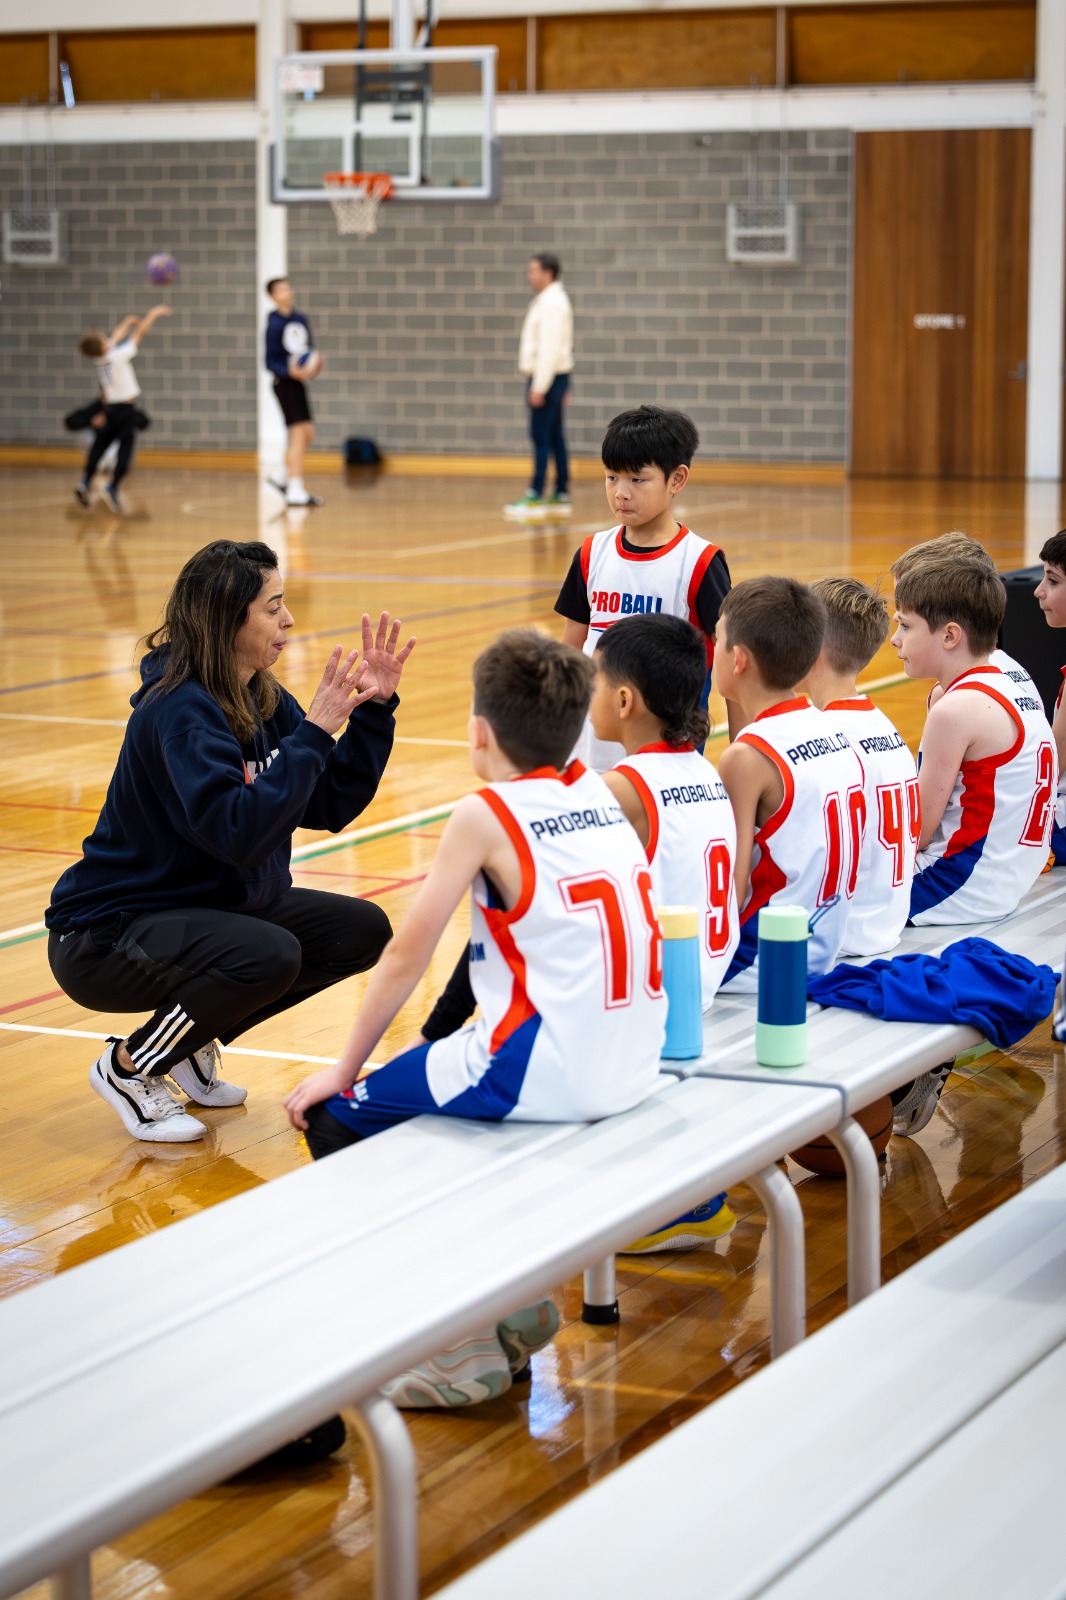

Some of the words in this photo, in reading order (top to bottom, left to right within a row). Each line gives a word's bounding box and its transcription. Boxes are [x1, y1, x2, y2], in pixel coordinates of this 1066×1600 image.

[591, 591, 662, 615] PROBALL
[704, 838, 735, 959] 9
[816, 784, 867, 907] 10
